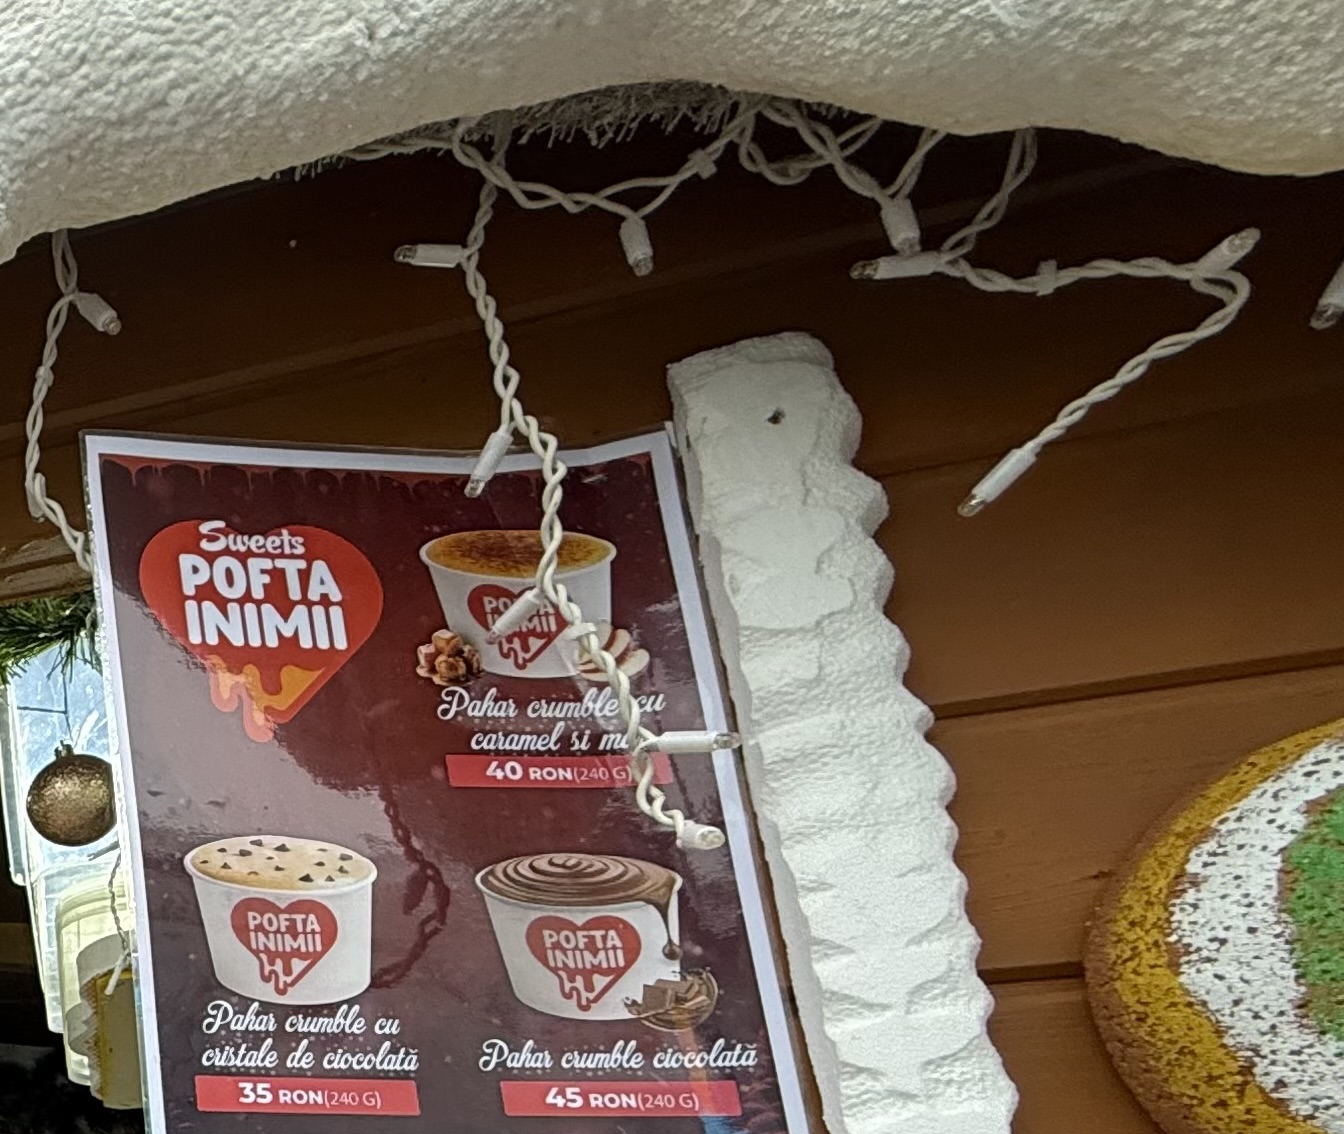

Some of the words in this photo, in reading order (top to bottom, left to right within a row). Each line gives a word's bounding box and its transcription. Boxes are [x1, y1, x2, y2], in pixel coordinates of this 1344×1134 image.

[198, 520, 306, 555] Sweets
[178, 553, 343, 602] POFTA
[483, 596, 555, 615] POA
[184, 600, 348, 650] INIMII
[437, 686, 518, 721] Pahar
[527, 686, 619, 718] crumble
[471, 721, 565, 751] caramel
[571, 729, 591, 750] si
[486, 761, 523, 780] 40
[247, 911, 321, 932] POFTA
[249, 931, 322, 953] INIMII
[542, 929, 623, 949] POFTA
[547, 949, 625, 968] INIMII
[202, 1000, 277, 1034] Pahar
[285, 1004, 367, 1034] crumble
[374, 1017, 400, 1035] cu
[201, 1038, 278, 1068] cristale
[286, 1039, 315, 1068] de
[323, 1041, 419, 1071] ciocolată
[478, 1039, 553, 1071] Pahar
[561, 1040, 644, 1069] crumble
[653, 1038, 758, 1068] ciocolată
[238, 1082, 273, 1104] 35
[545, 1087, 584, 1108] 45
